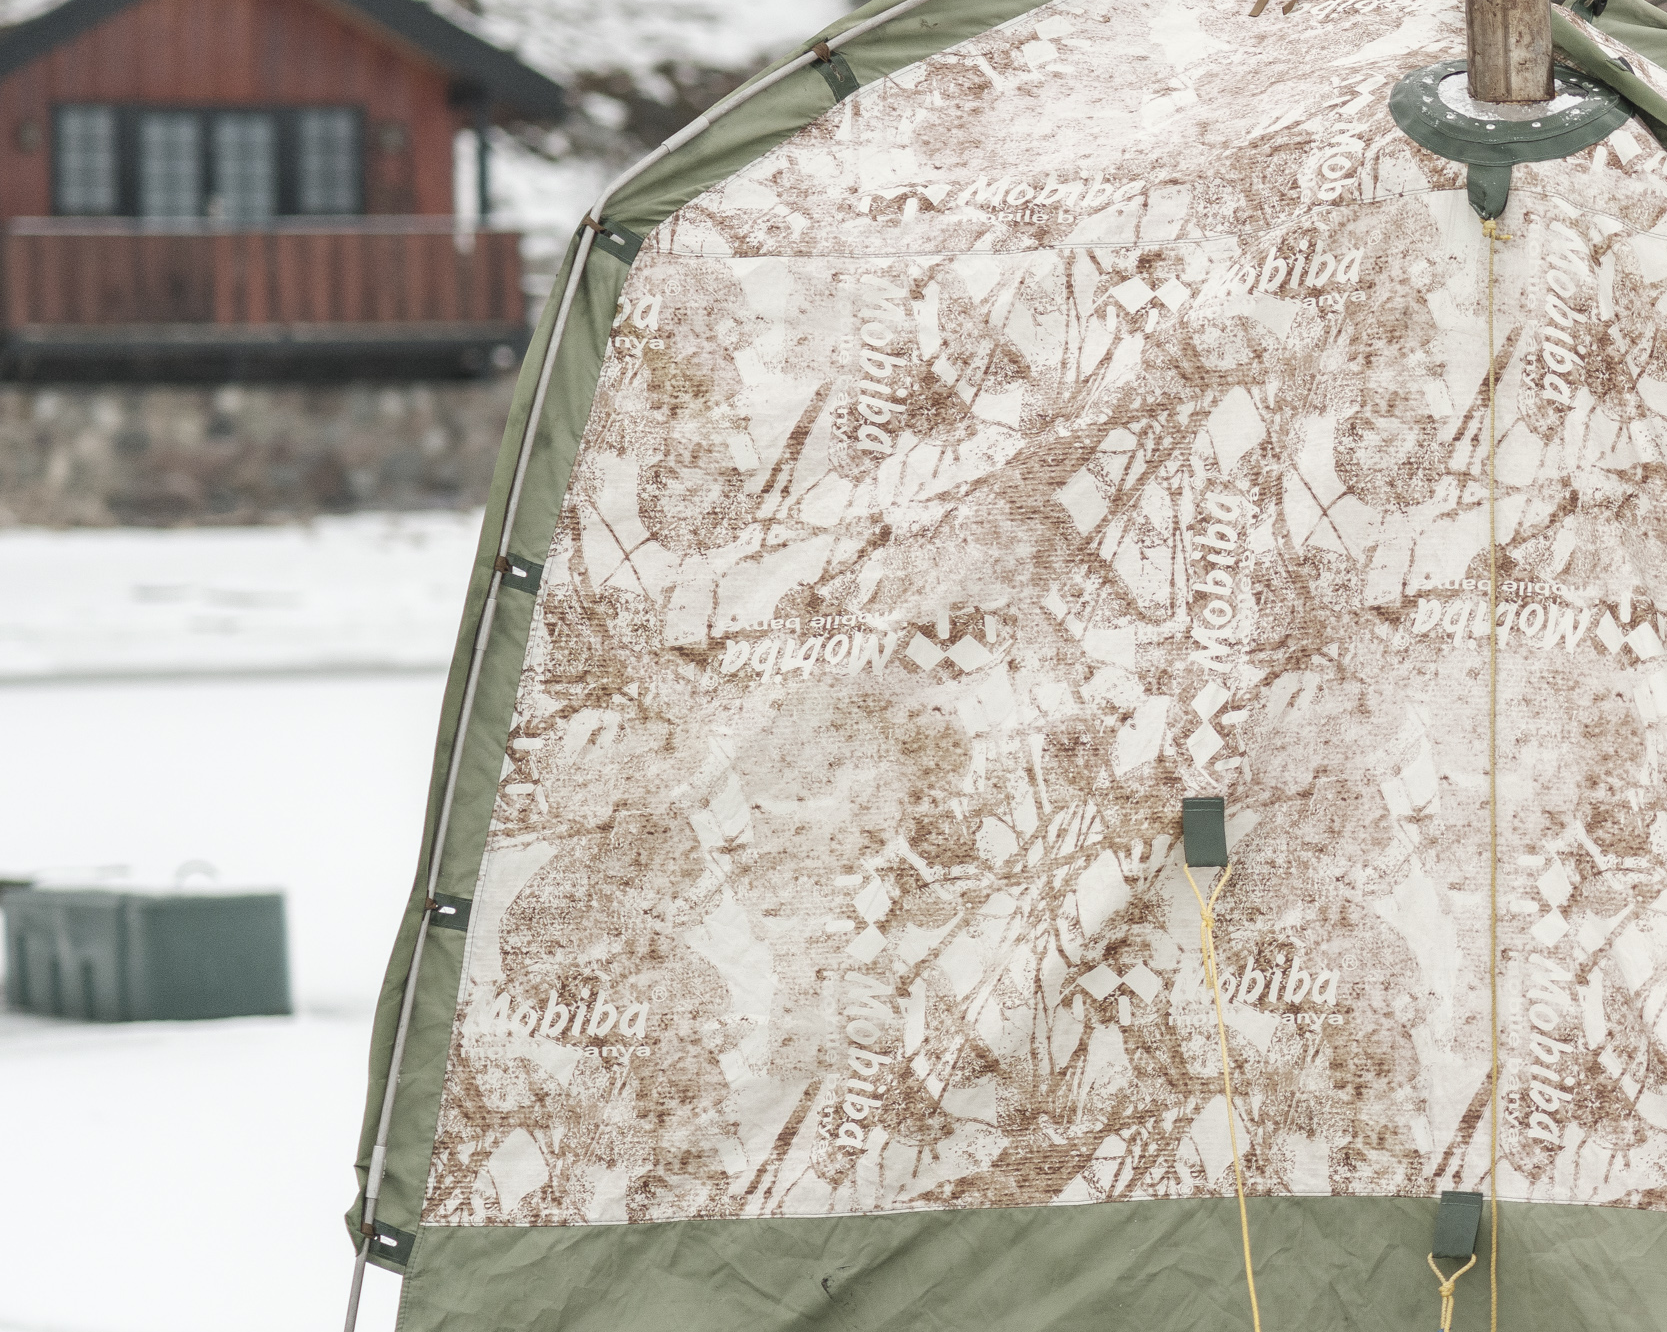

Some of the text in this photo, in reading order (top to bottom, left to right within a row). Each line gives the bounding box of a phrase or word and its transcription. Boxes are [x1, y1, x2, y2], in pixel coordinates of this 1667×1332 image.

[857, 274, 909, 455] Mobiba
[1542, 221, 1591, 406] Mobiba
[720, 630, 899, 683] Mobiba
[1189, 491, 1239, 673] Mobiba
[1412, 597, 1592, 657] Mobiba
[836, 970, 893, 1150] Mobiba
[1526, 953, 1576, 1145] Mobiba
